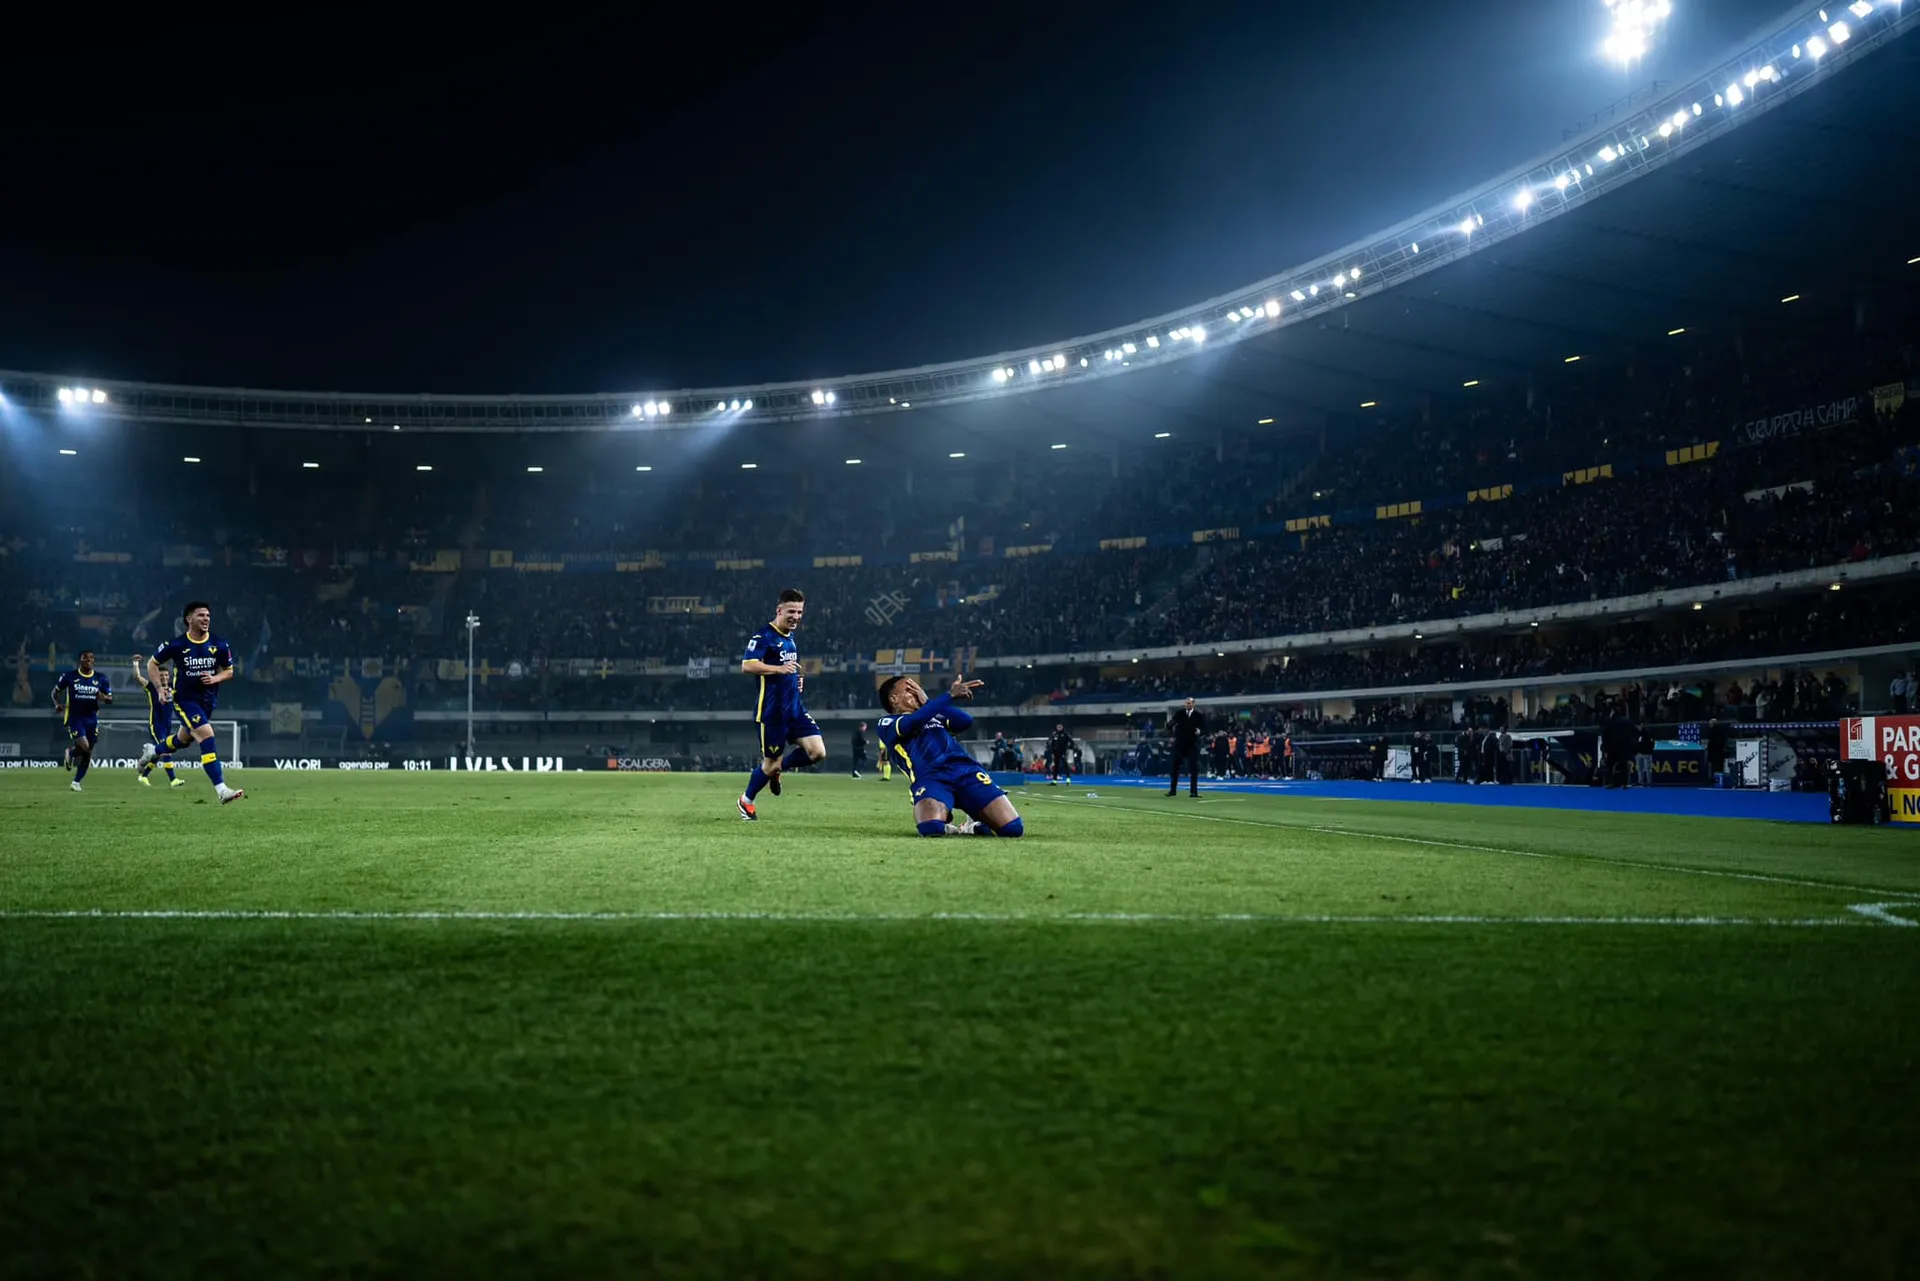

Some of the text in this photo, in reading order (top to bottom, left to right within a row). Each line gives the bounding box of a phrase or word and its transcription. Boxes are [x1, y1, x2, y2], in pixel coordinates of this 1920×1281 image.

[183, 656, 217, 666] Sinergy
[30, 760, 58, 768] lavoro
[274, 759, 321, 770] VALORI
[339, 760, 373, 770] agenzia
[402, 760, 431, 770] 10:11
[618, 757, 671, 769] SCALIGERA
[1677, 760, 1700, 774] FC
[976, 771, 993, 785] 9
